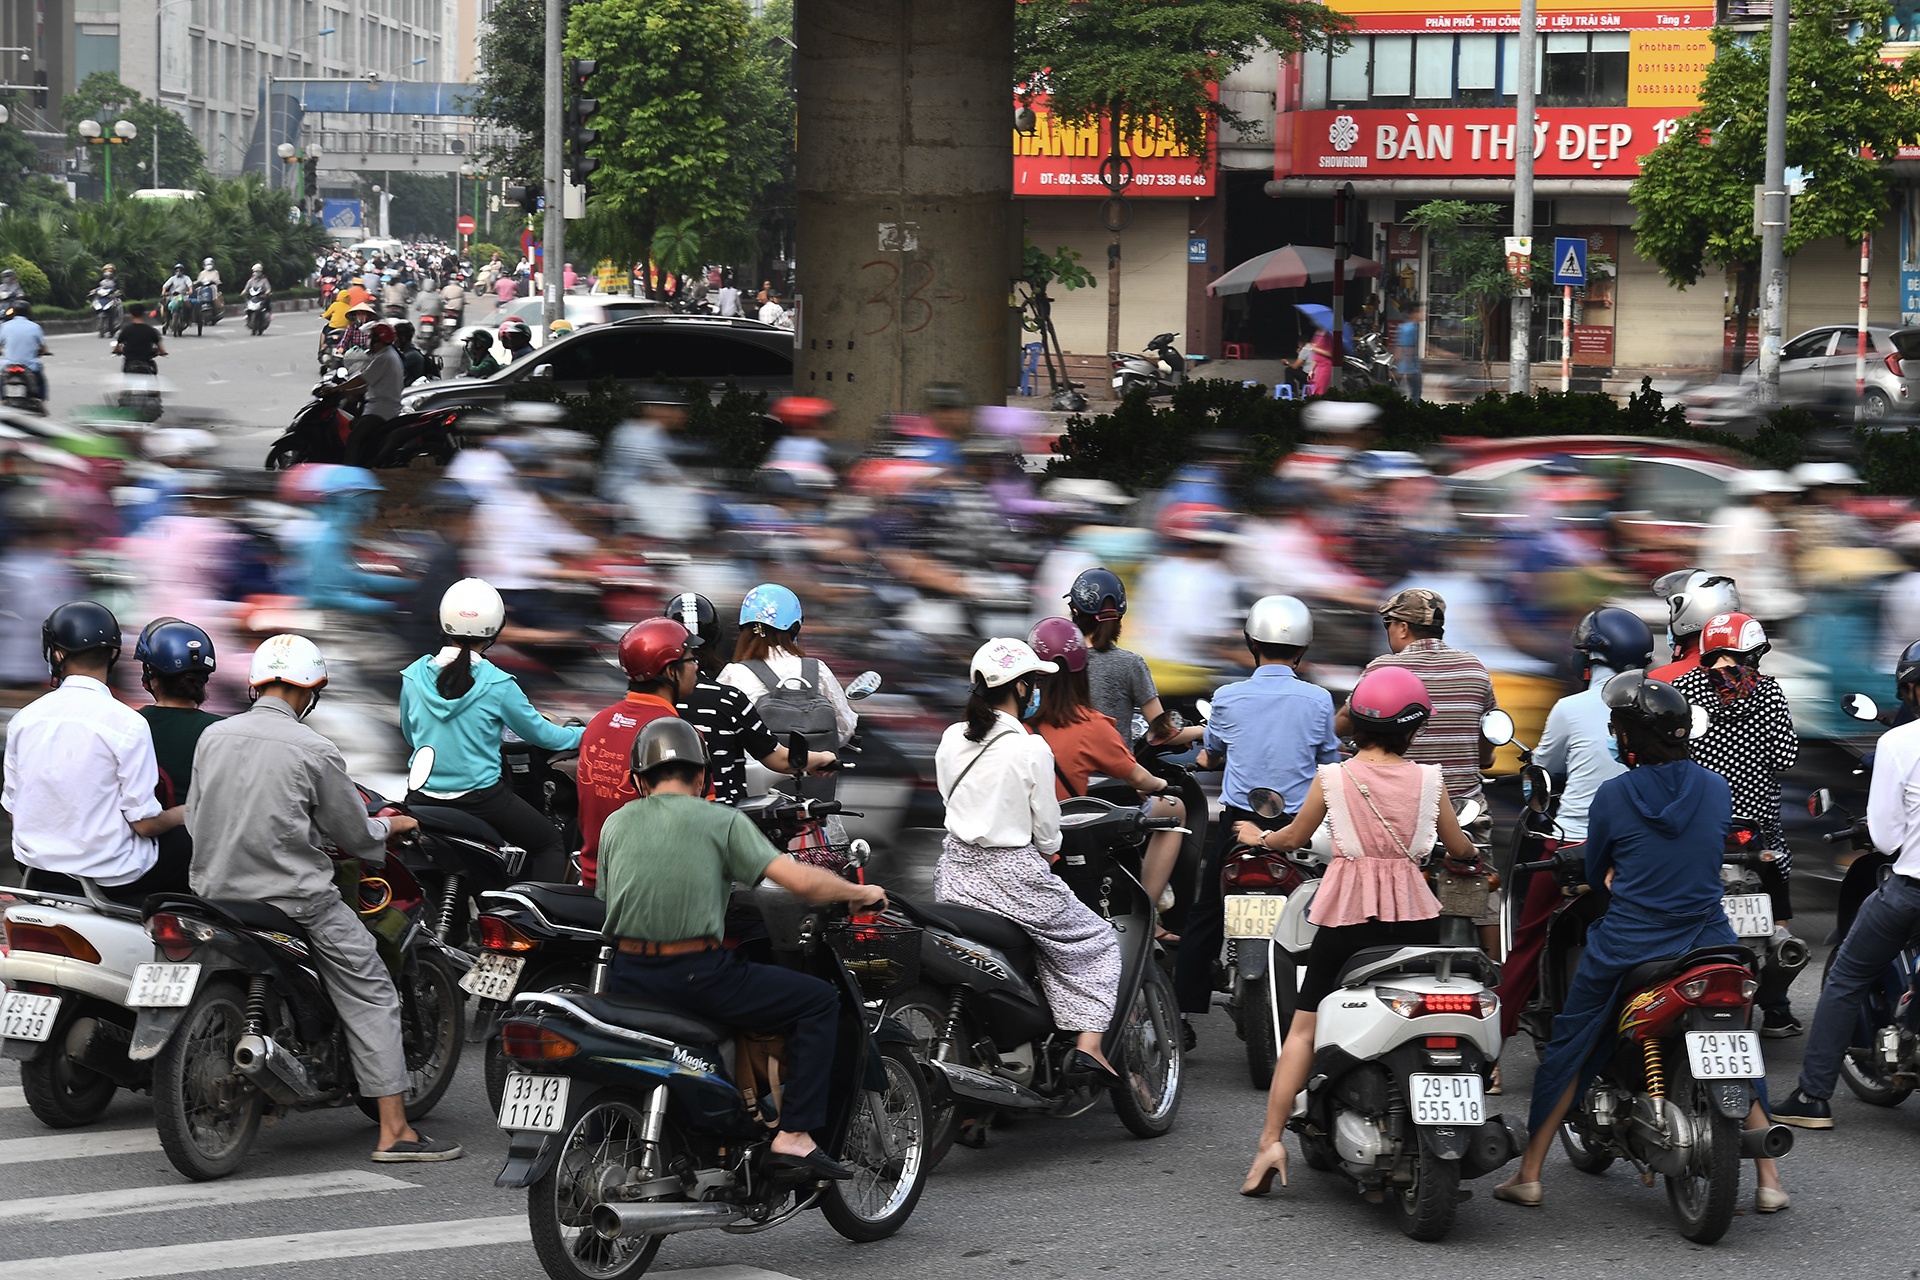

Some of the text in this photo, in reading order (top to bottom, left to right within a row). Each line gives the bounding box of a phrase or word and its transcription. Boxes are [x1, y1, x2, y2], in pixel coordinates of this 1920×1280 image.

[1426, 16, 1451, 27] PHÂN
[1453, 15, 1475, 27] PHỐI
[1482, 17, 1496, 27] THI
[1552, 15, 1572, 28] LIỆU
[1683, 15, 1690, 24] 2
[1376, 113, 1455, 160] BÀN
[1556, 123, 1633, 169] ĐẸP
[1319, 156, 1368, 168] SHOWROOM
[3, 1015, 44, 1037] 1239
[1698, 1034, 1748, 1053] 29-V6
[672, 1046, 709, 1071] Magic
[1701, 1055, 1752, 1074] 8565
[513, 1076, 560, 1102] 33-K3
[1422, 1078, 1471, 1098] 29-D1
[510, 1102, 555, 1127] 1126
[1418, 1100, 1479, 1121] 555.18
